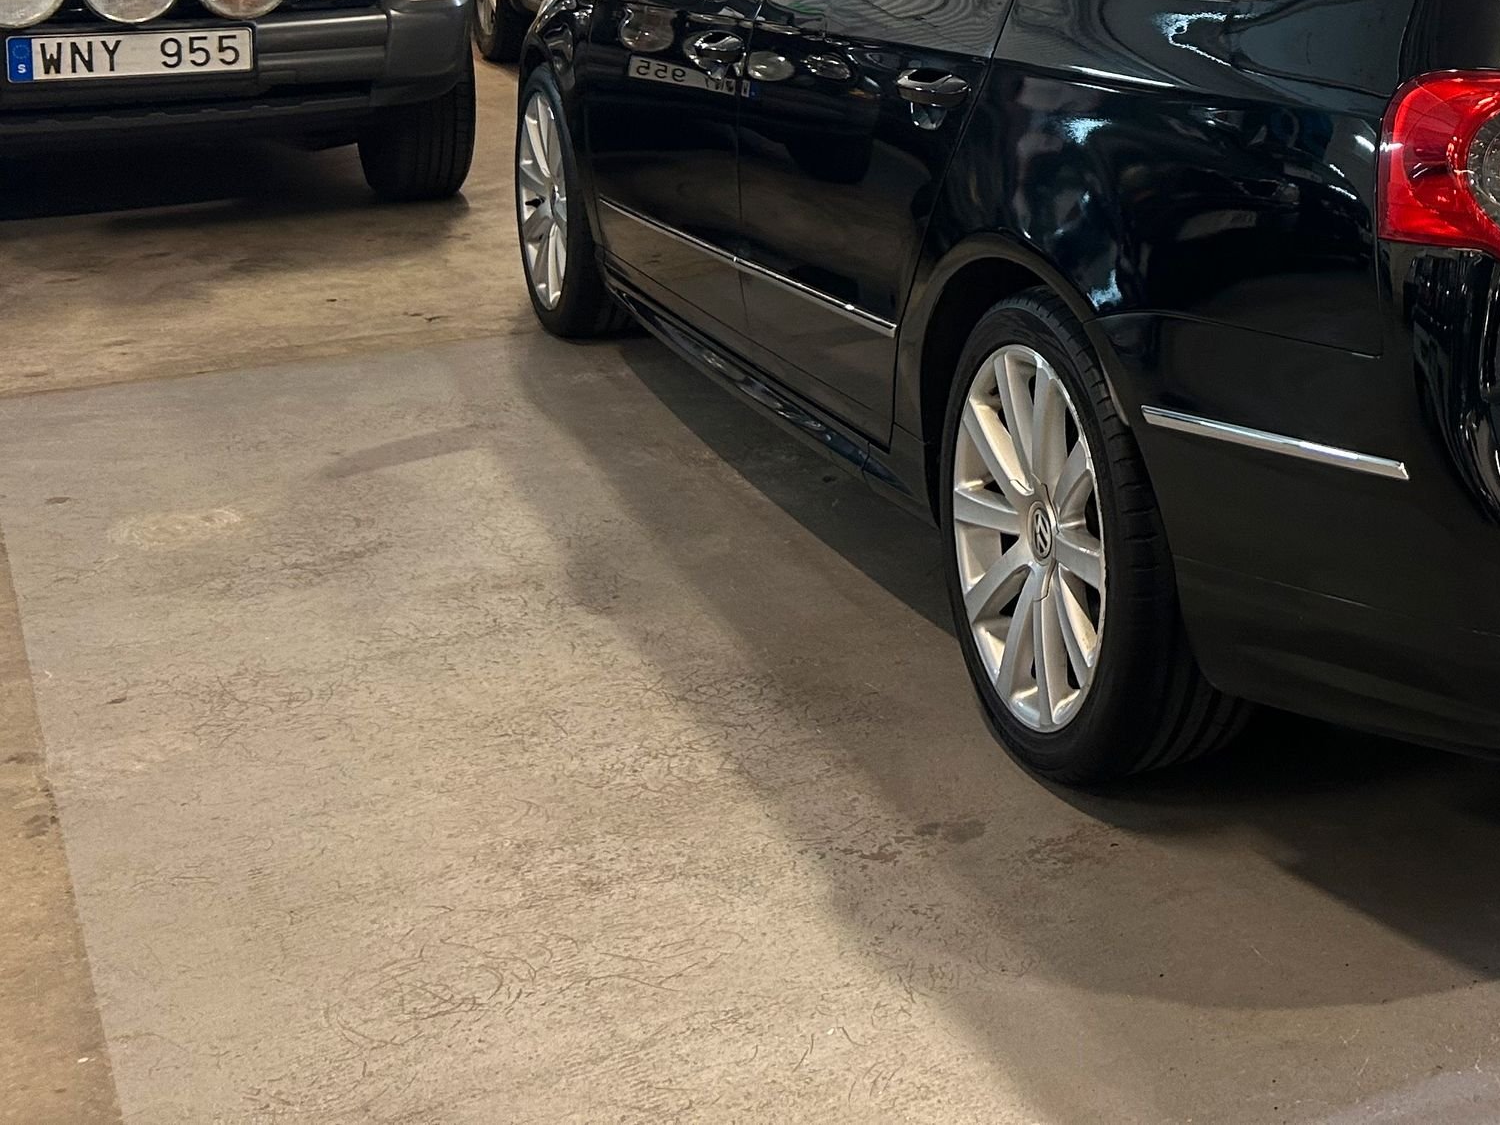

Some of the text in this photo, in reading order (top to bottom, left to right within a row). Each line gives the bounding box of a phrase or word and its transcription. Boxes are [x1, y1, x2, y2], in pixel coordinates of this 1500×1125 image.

[17, 34, 240, 75] S WNY 955
